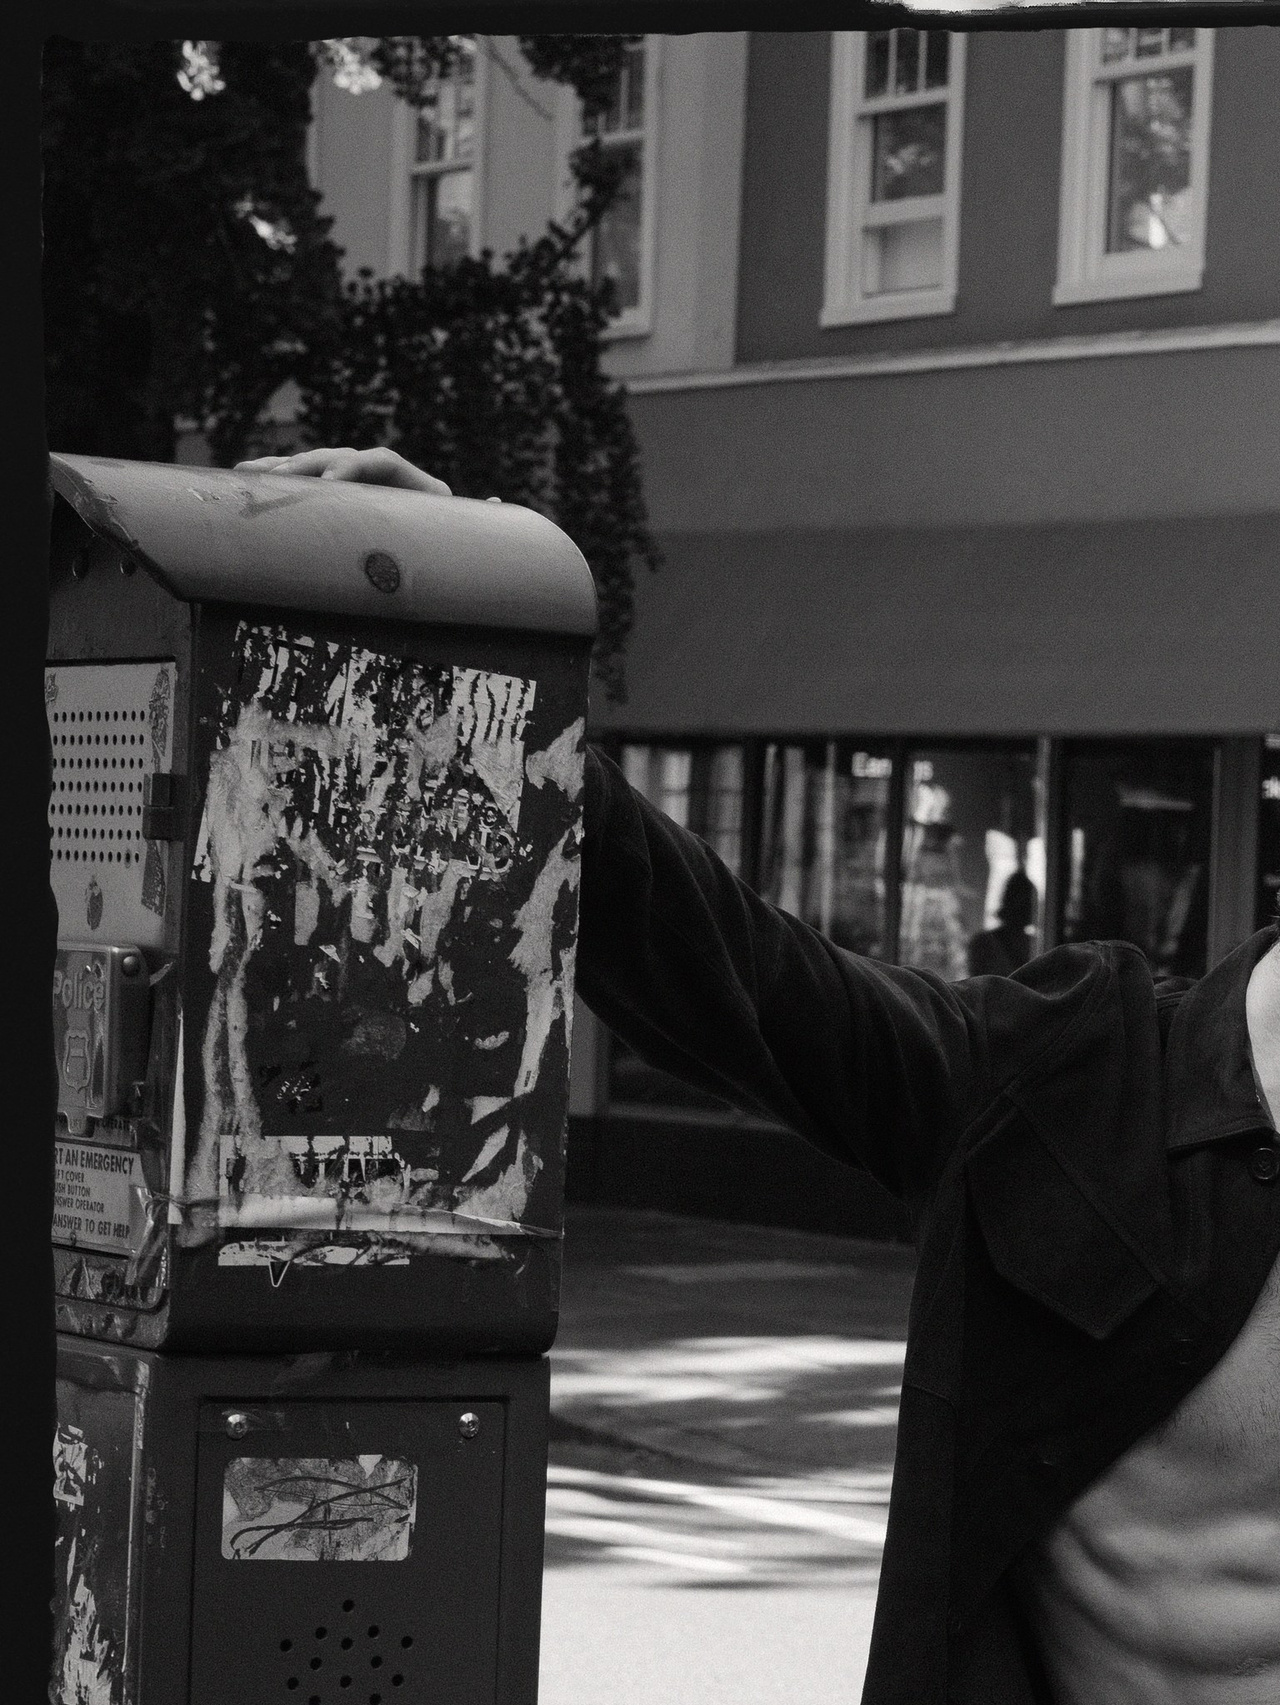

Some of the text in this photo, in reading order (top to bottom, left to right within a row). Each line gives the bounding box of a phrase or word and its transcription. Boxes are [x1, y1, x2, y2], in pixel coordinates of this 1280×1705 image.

[53, 970, 104, 1010] Police
[65, 1149, 79, 1168] AN
[81, 1150, 134, 1175] EMERGENCY
[66, 1170, 84, 1183] COVER
[68, 1184, 91, 1198] BUTTON
[76, 1198, 104, 1213] OPERATOR
[53, 1213, 130, 1238] ANSWER TO GET HELP
